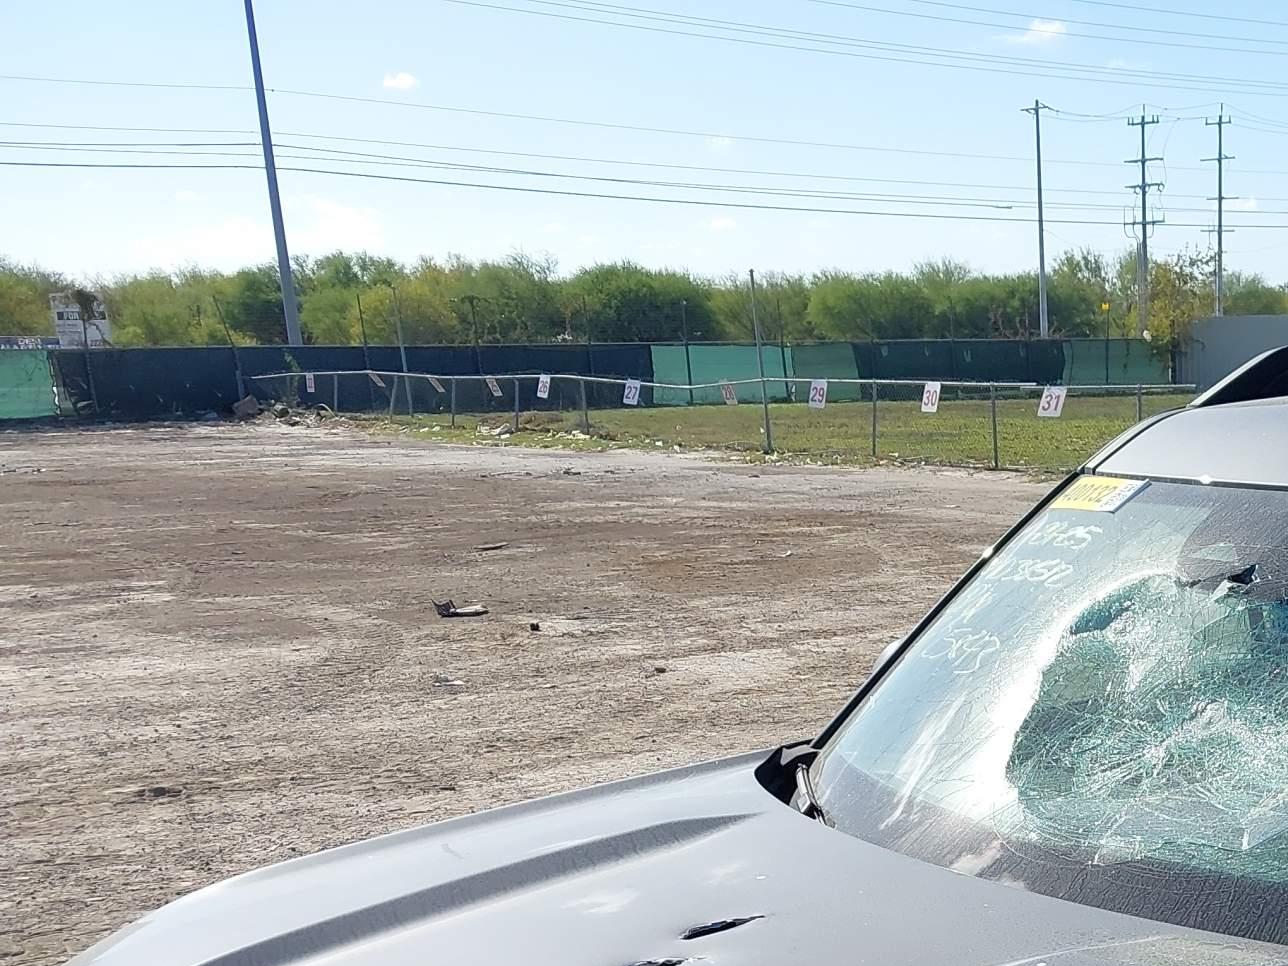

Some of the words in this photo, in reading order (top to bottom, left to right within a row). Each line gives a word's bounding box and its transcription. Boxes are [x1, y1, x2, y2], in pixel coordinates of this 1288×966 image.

[537, 379, 549, 394] 26
[624, 385, 639, 401] 27
[810, 386, 826, 404] 29
[922, 388, 938, 407] 30
[1041, 393, 1062, 412] 31
